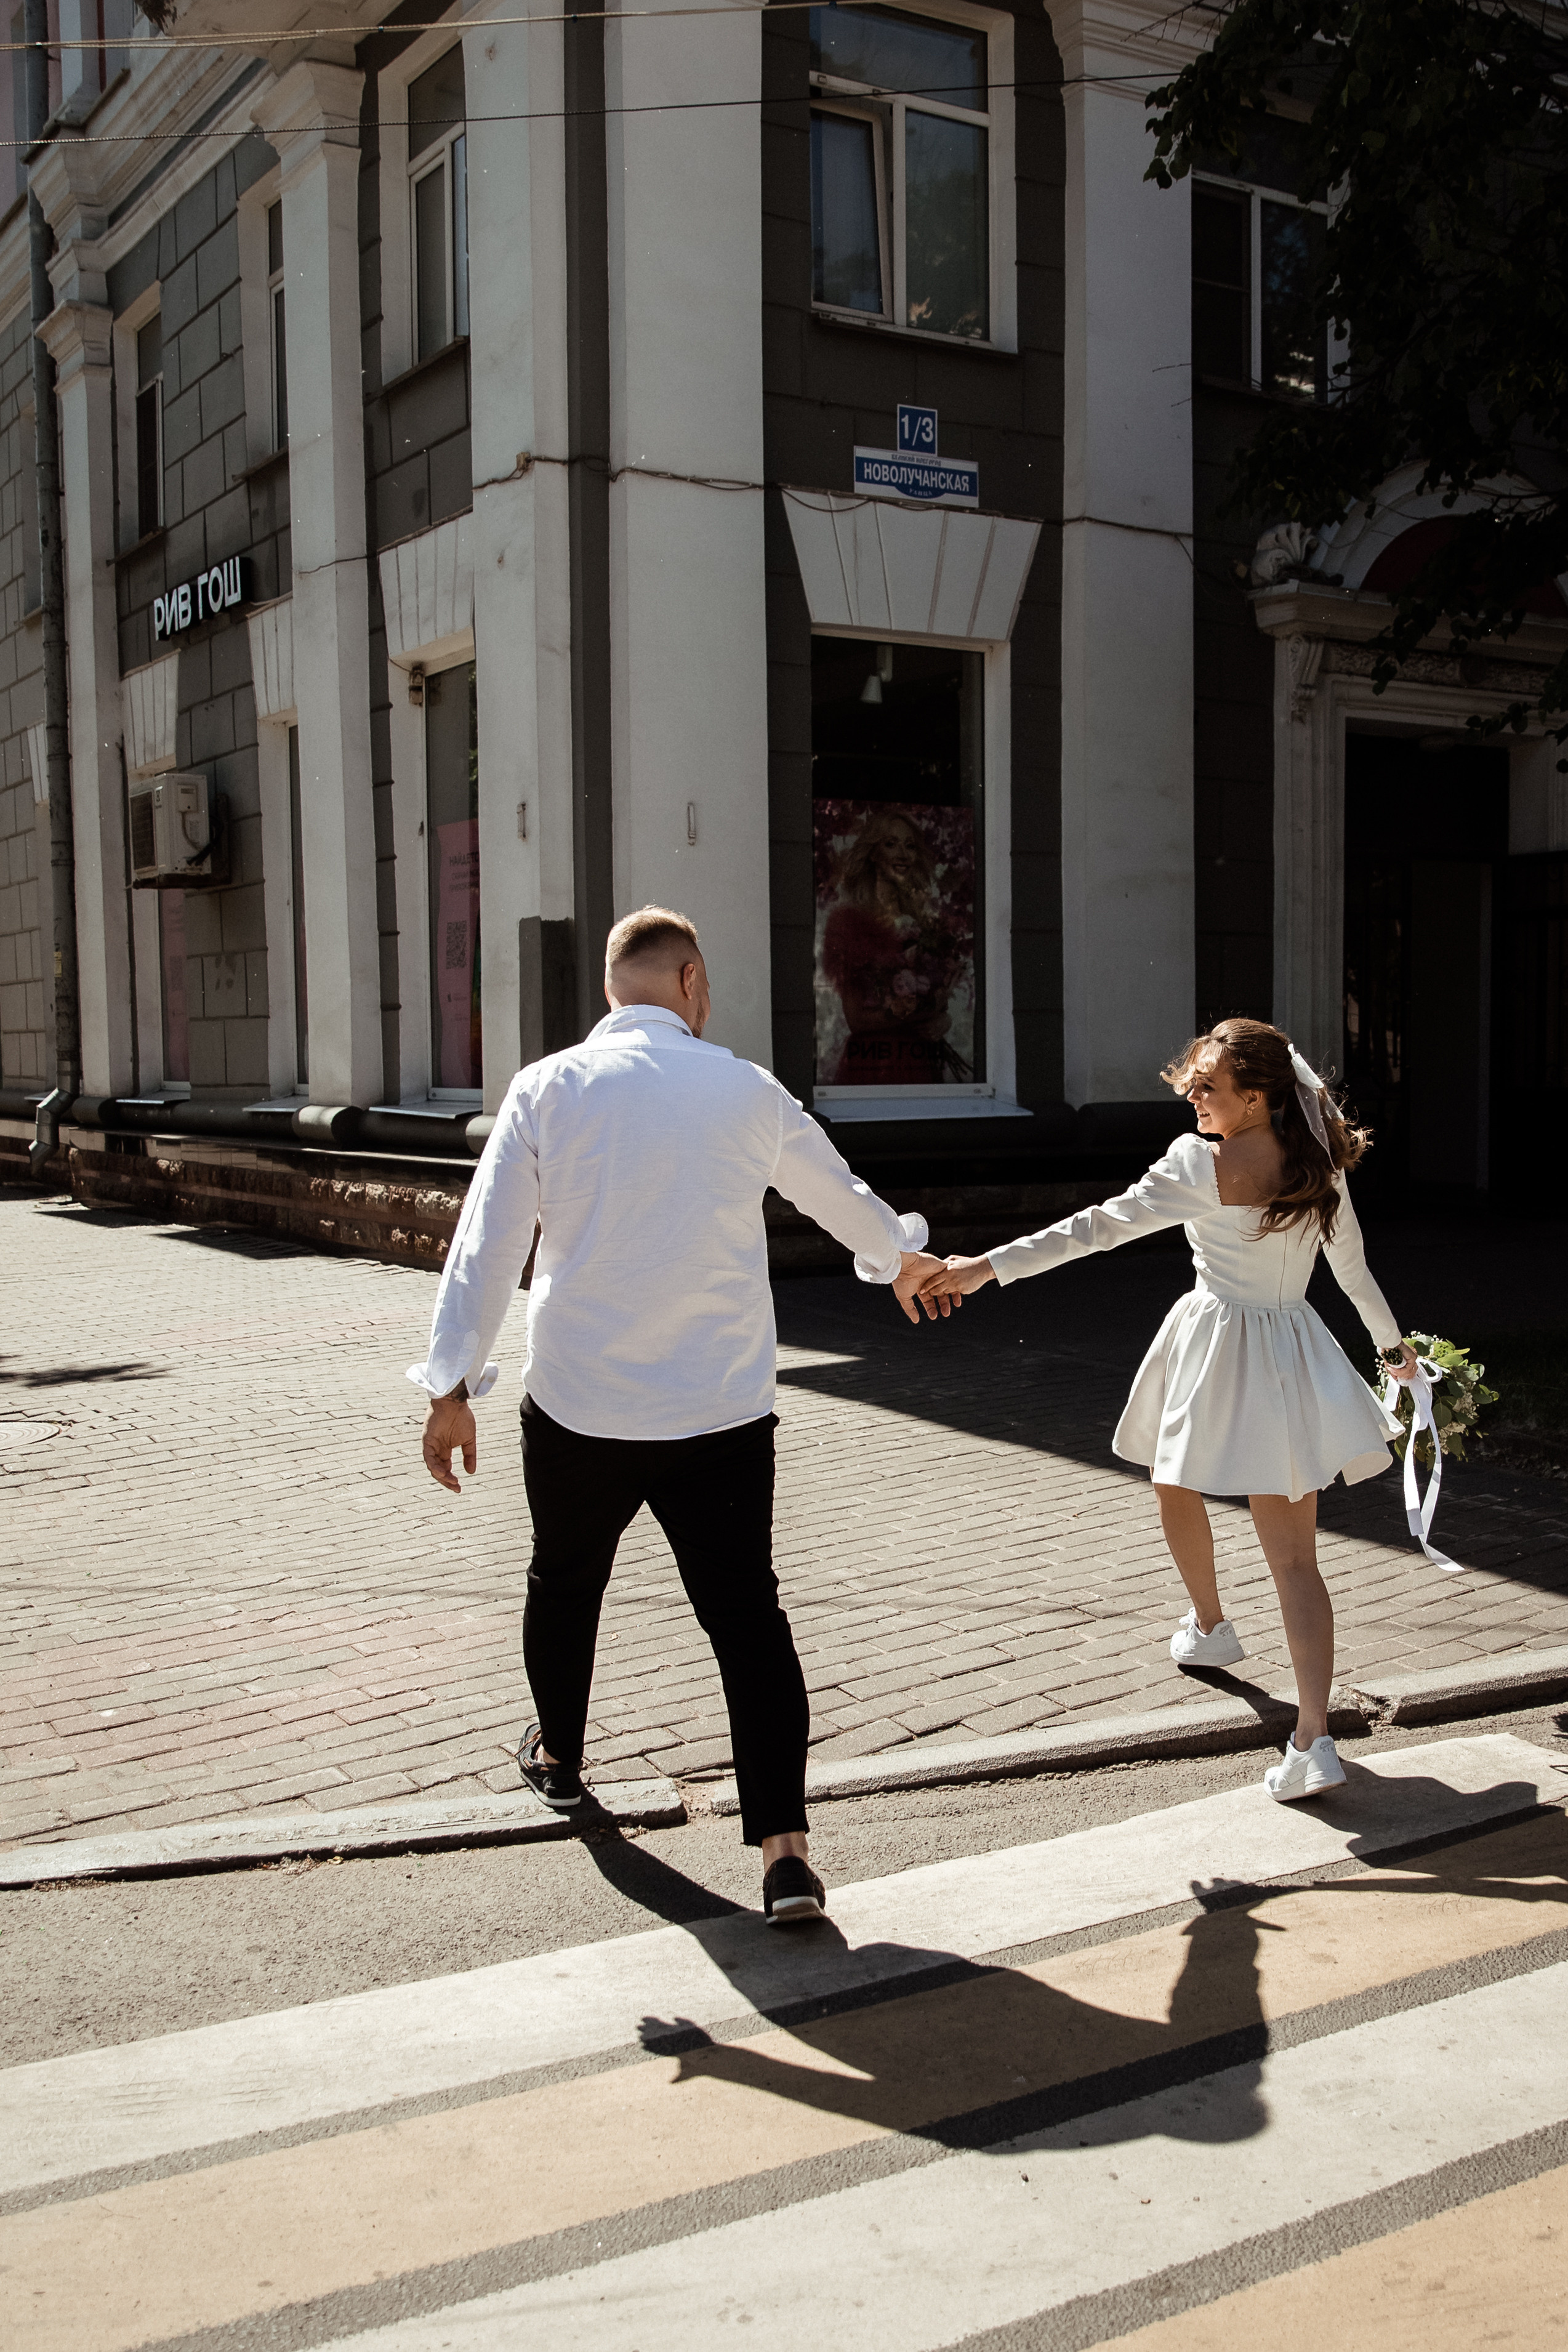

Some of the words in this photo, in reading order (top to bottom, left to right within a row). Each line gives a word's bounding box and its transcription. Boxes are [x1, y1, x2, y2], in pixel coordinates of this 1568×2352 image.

[901, 414, 934, 446] 1/3
[864, 462, 970, 492] НОВОЛУЧАНСКАЯ
[153, 583, 192, 642] РИВ
[197, 555, 242, 620] ГОШ
[848, 1041, 892, 1060] РИВ
[896, 1040, 944, 1060] ГОШ
